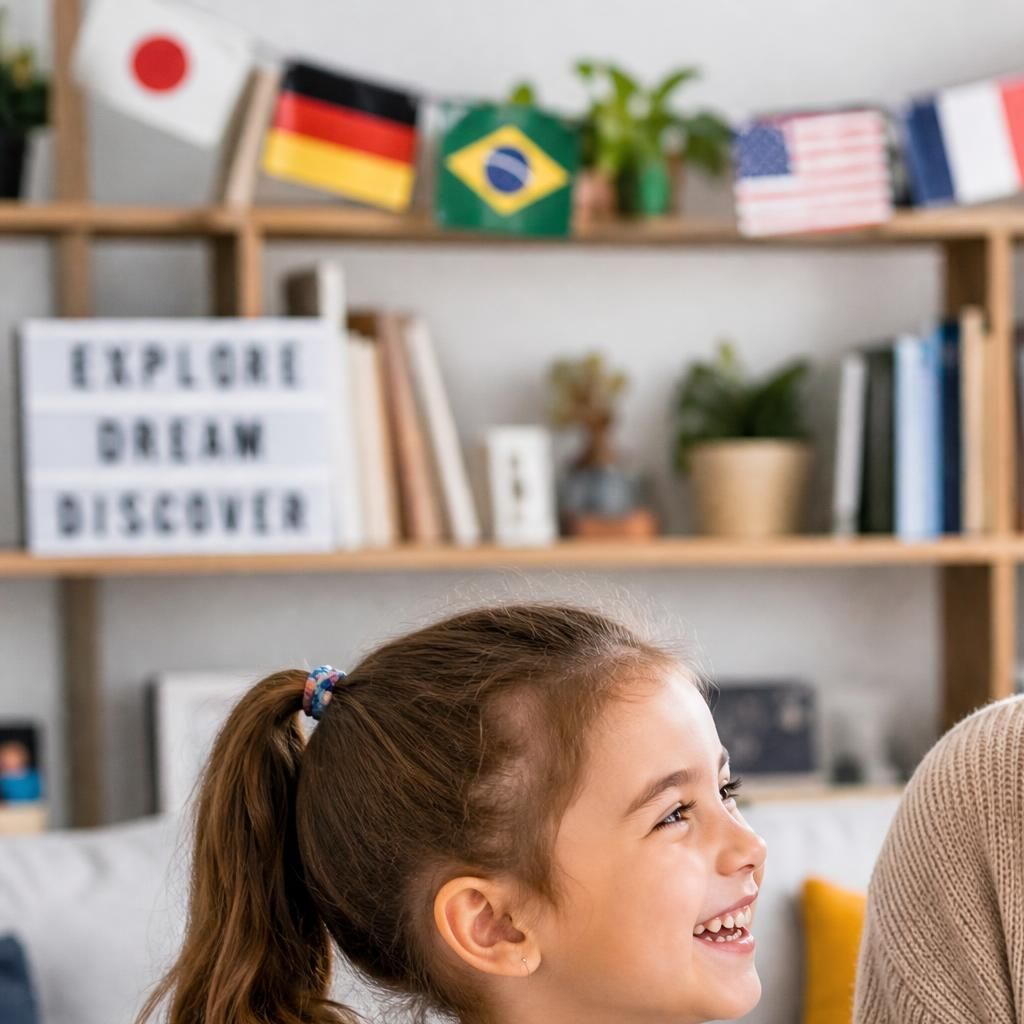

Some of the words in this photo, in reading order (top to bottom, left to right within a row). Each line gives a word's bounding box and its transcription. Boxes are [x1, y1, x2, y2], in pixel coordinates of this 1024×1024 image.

[70, 341, 303, 391] EXPLORE
[97, 416, 265, 465] DREAM
[56, 489, 306, 538] DISCOVER
